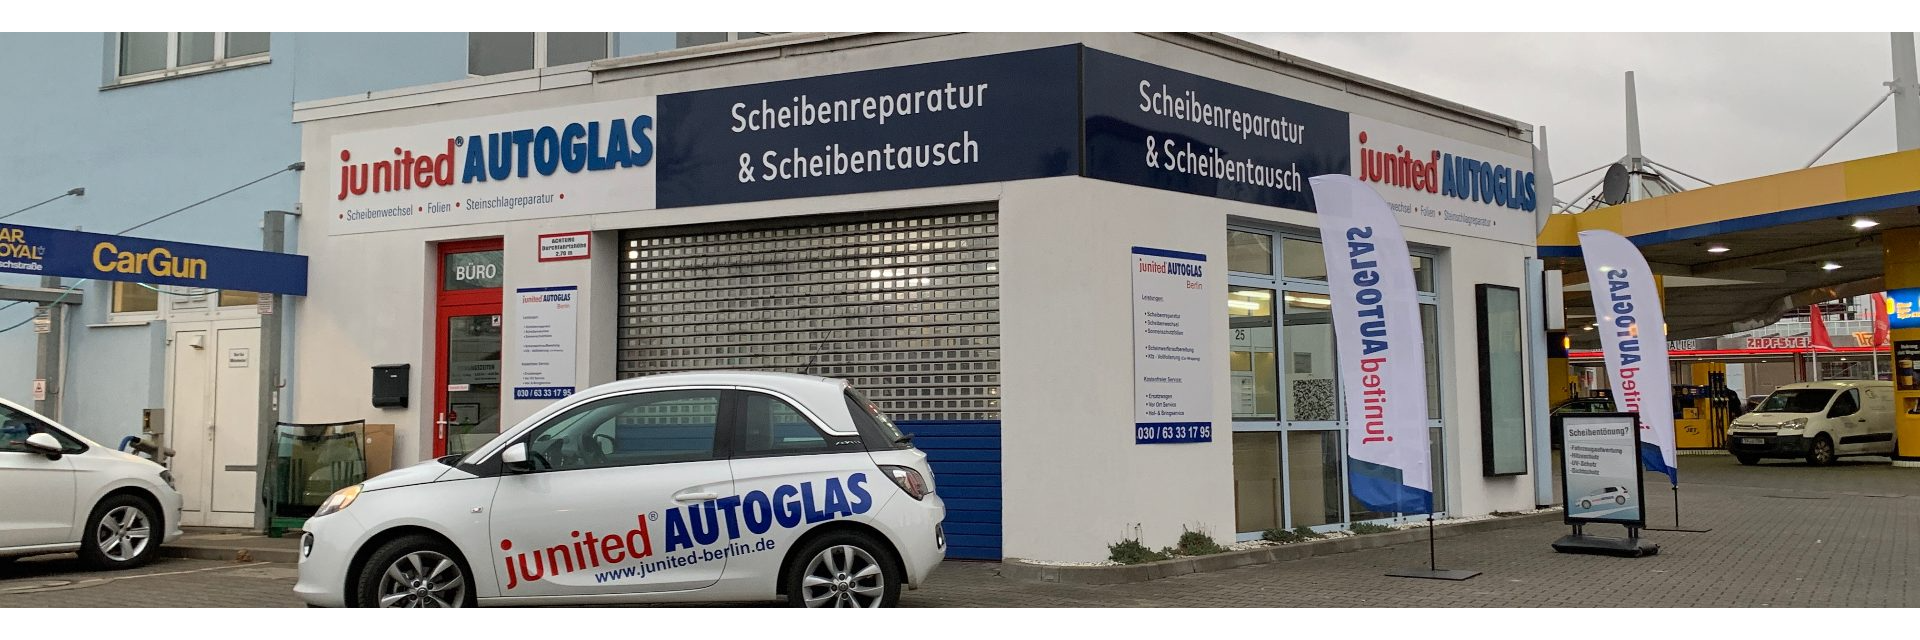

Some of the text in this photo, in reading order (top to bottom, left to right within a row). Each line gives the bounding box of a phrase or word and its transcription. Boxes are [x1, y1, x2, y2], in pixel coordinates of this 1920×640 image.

[731, 83, 988, 133] Scheibenreparatur
[1139, 80, 1304, 144] Scheibenreparatur
[462, 115, 653, 183] AUTOGLAS
[738, 130, 978, 183] & Scheibentausch
[1146, 135, 1301, 192] & Scheibentausch
[1442, 153, 1536, 212] AUTOGLAS
[347, 193, 554, 221] Scheibenwechsel Folien Steinschlagreparatur
[1420, 205, 1436, 217] Folien
[92, 241, 207, 280] CarGun
[456, 263, 497, 281] BÜRO
[1139, 257, 1203, 278] junited AUTOGLAS
[543, 293, 571, 302] AUTOGLAS
[1186, 280, 1203, 290] Berlin
[1235, 329, 1245, 341] 25
[517, 389, 529, 397] 030
[533, 389, 542, 397] 63
[543, 389, 551, 397] 33
[1138, 426, 1154, 440] 030
[1162, 426, 1173, 439] 63
[1175, 426, 1186, 439] 33
[1188, 426, 1198, 438] 17
[1200, 426, 1210, 438] 95
[1569, 426, 1629, 437] Scheibentönung?
[664, 472, 873, 553] AUTOGLAS
[594, 537, 776, 584] www.junited-berlin.de
